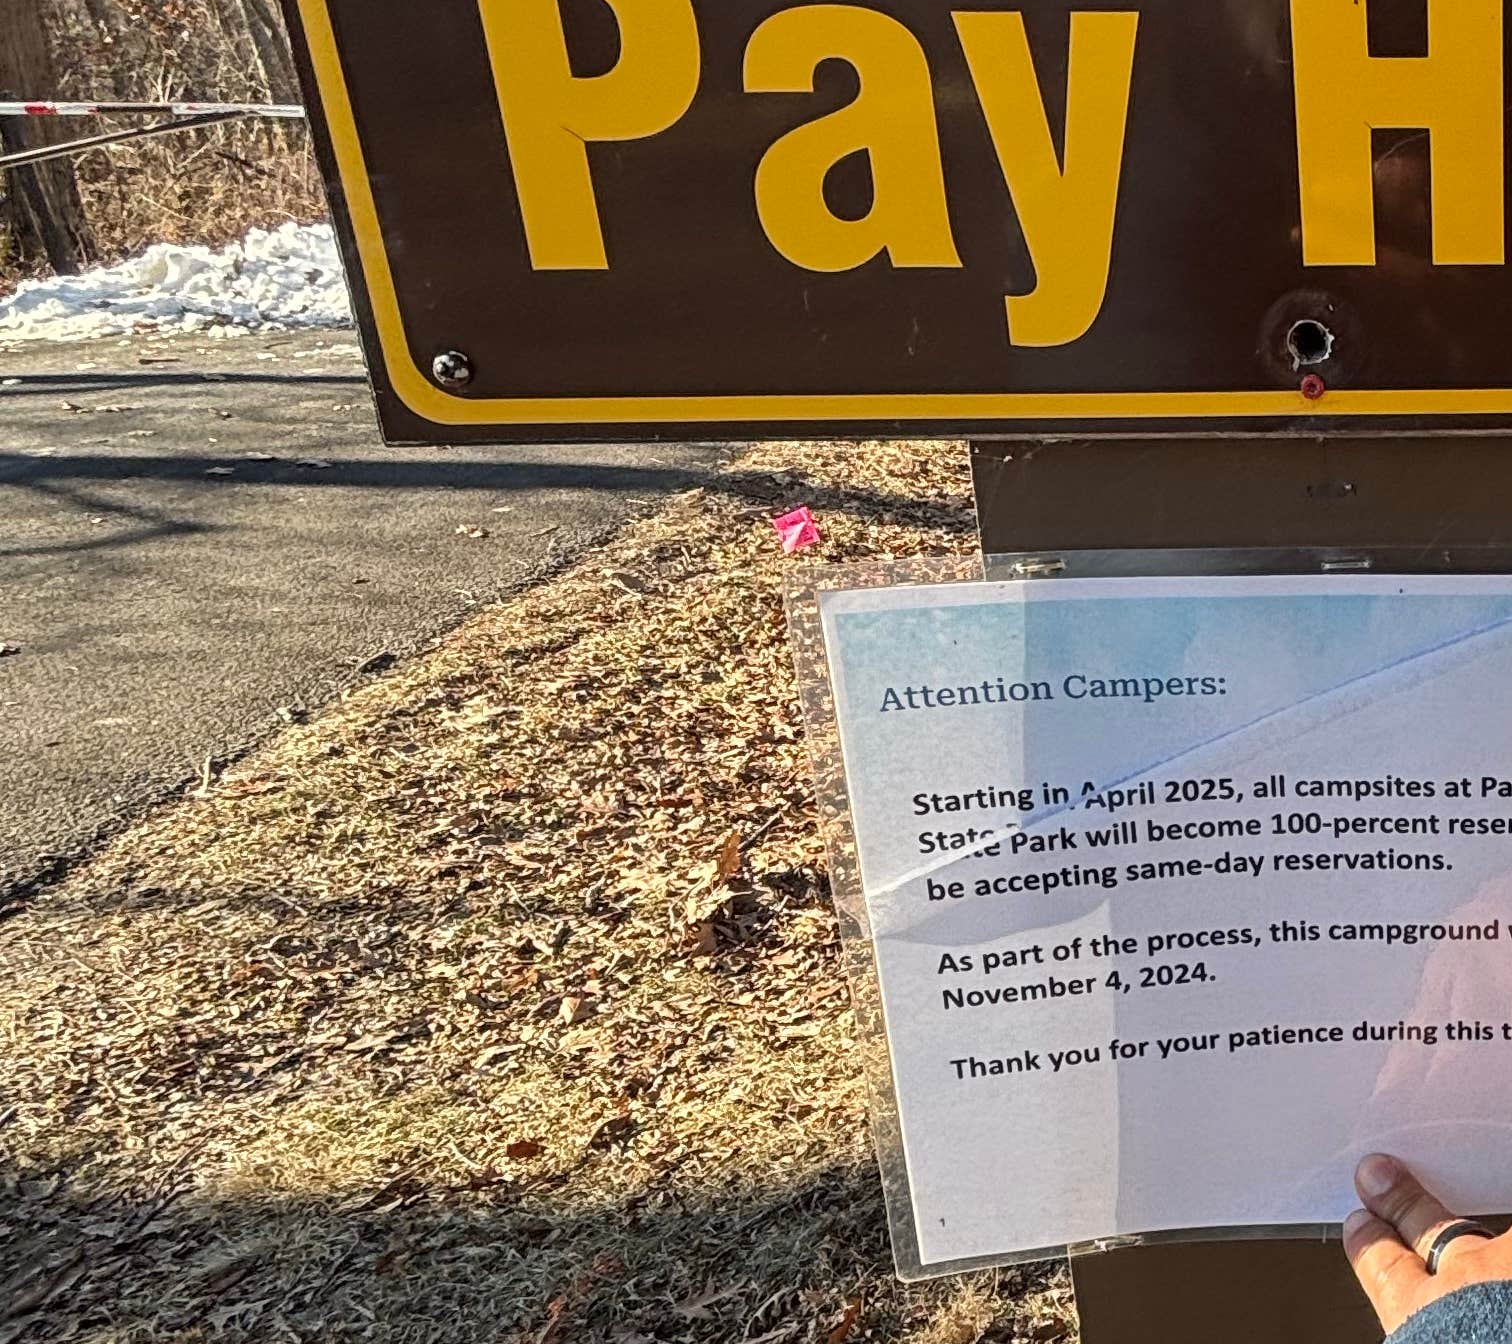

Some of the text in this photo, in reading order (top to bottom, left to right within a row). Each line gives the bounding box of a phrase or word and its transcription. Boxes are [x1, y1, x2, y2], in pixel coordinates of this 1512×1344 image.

[880, 674, 1227, 712] Attention Campers:
[913, 781, 1034, 816] Starting
[1042, 782, 1070, 805] in
[1081, 777, 1155, 813] April
[1164, 777, 1244, 804] 2025,
[1253, 775, 1286, 799] all
[1295, 774, 1436, 802] campsites
[1444, 777, 1472, 799] at
[918, 828, 1001, 859] State
[1010, 826, 1078, 855] Park
[1085, 820, 1138, 848] will
[1147, 818, 1262, 843] become
[1271, 812, 1441, 839] 100-percent
[926, 847, 1453, 902] be accepting same-day reservations.
[937, 952, 974, 975] As
[983, 944, 1045, 975] part
[1052, 938, 1083, 962] of
[1088, 934, 1138, 959] the
[1148, 927, 1262, 957] process,
[1269, 919, 1321, 943] this
[1328, 918, 1500, 945] campground
[942, 961, 1217, 1011] November 4, 2024.
[949, 1049, 1042, 1080] Thank
[1047, 1046, 1101, 1073] you
[1108, 1035, 1150, 1061] for
[1155, 1033, 1221, 1060] your
[1228, 1024, 1344, 1053] patience
[1352, 1020, 1439, 1046] during
[1444, 1019, 1494, 1044] this
